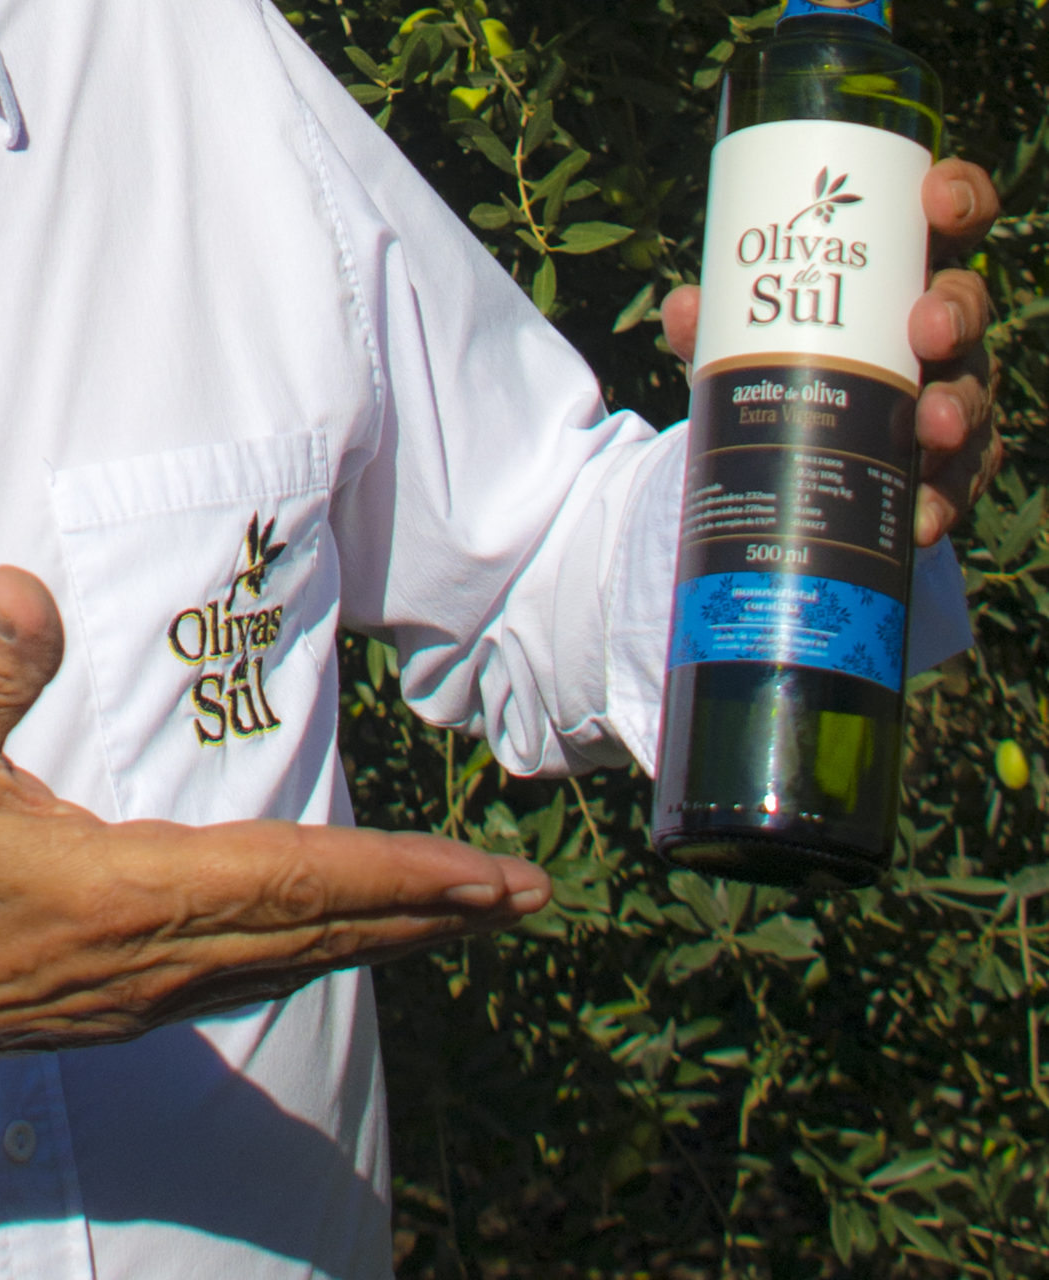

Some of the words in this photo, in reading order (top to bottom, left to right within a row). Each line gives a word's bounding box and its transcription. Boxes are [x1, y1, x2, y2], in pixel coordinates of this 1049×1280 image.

[735, 222, 868, 269] Olivas
[791, 263, 821, 285] do
[747, 272, 846, 328] Sul
[732, 379, 784, 405] azeite
[784, 387, 800, 401] de
[801, 379, 848, 408] oliva
[738, 405, 778, 425] Extra
[781, 404, 837, 429] Virgem
[745, 543, 782, 562] 500
[784, 546, 809, 564] ml
[167, 600, 283, 666] Olivas
[191, 656, 282, 748] Sul
